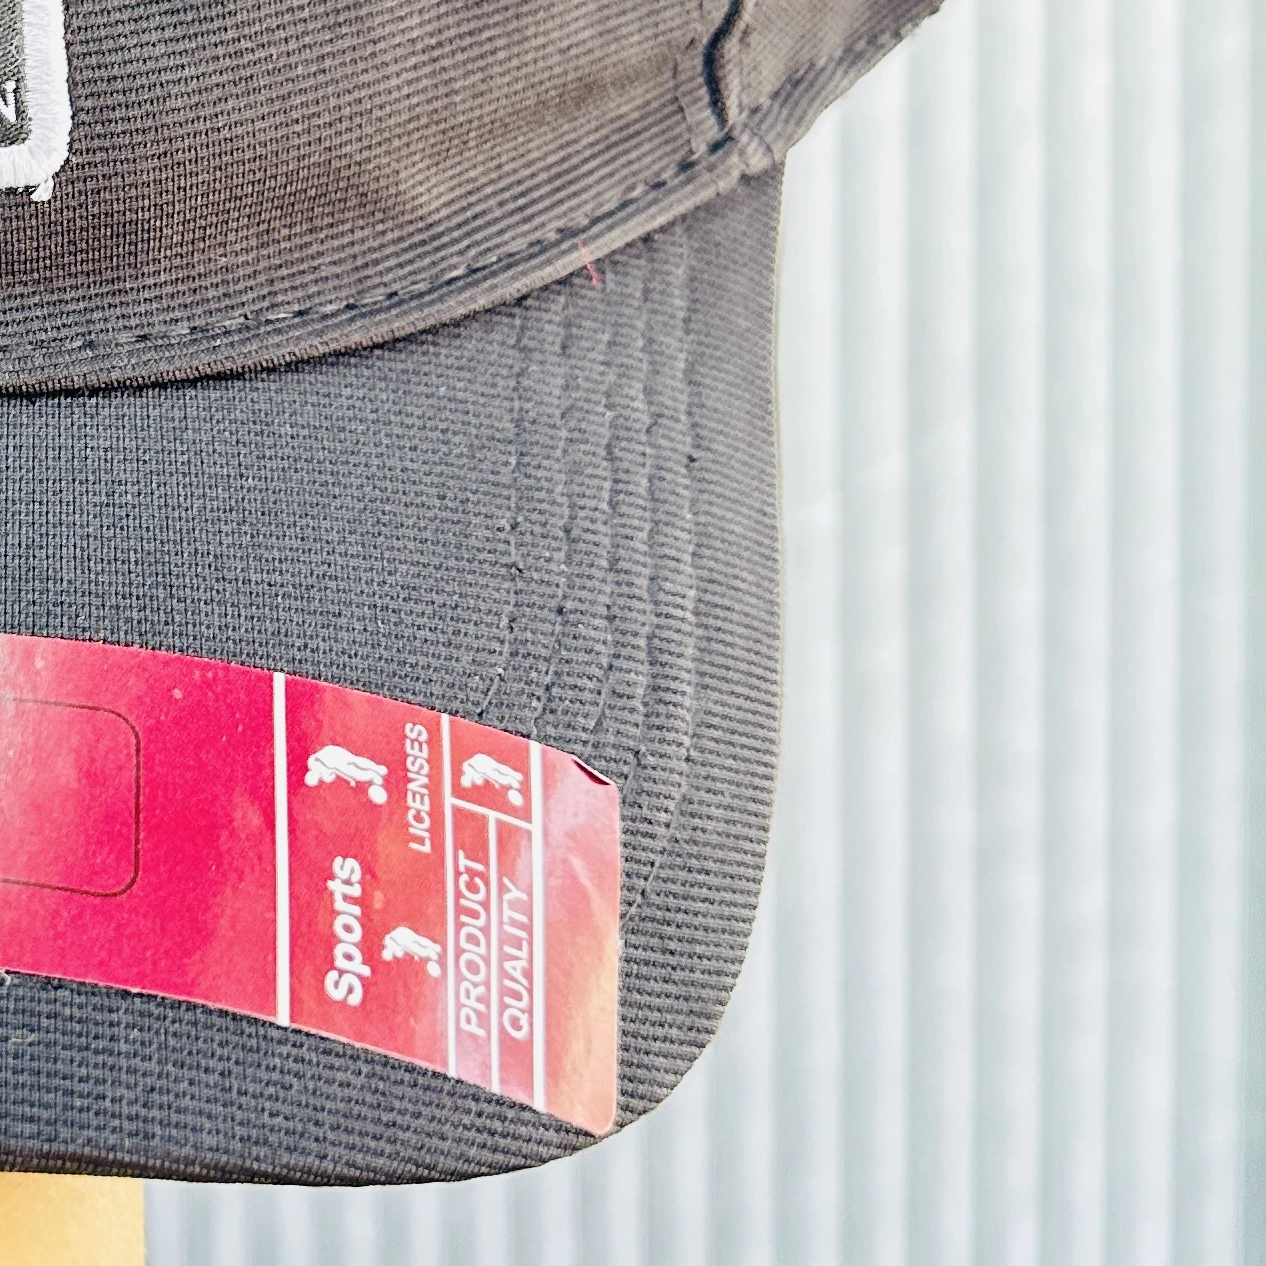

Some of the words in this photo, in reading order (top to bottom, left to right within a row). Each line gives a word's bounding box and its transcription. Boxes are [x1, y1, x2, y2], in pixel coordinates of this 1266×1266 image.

[405, 722, 432, 854] LICENSES
[325, 855, 371, 1006] Sports
[459, 851, 488, 1036] PRODUCT
[502, 877, 531, 1040] QUALITY
